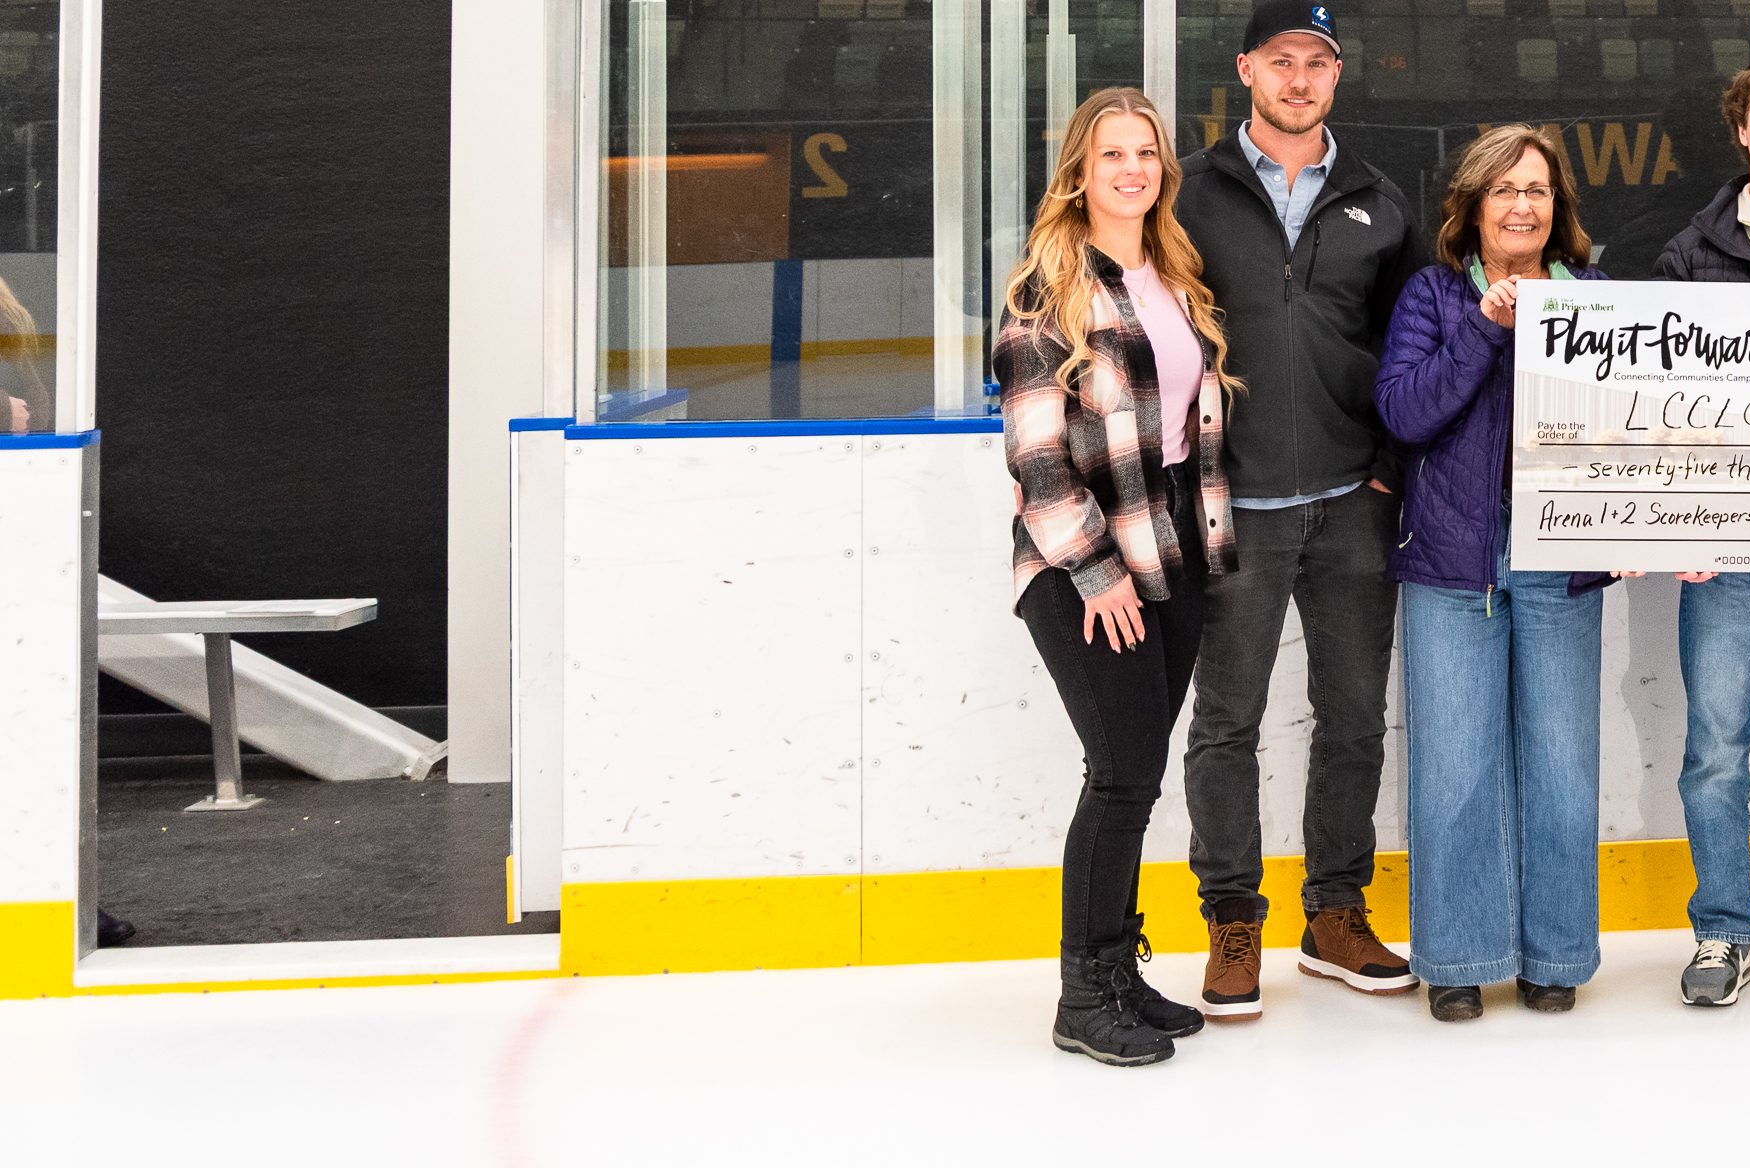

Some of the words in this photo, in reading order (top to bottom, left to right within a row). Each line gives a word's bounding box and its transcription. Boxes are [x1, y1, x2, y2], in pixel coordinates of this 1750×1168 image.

[1561, 303, 1588, 311] Prince
[1588, 303, 1615, 311] Albert
[1539, 308, 1615, 381] Play
[1617, 322, 1658, 366] it
[1613, 372, 1665, 383] Connecting
[1666, 372, 1725, 383] Communities
[1537, 421, 1555, 432] Pay
[1557, 422, 1567, 431] to
[1569, 421, 1586, 430] the
[1537, 430, 1565, 440] Order
[1567, 430, 1579, 440] of
[1539, 499, 1594, 533] Arena
